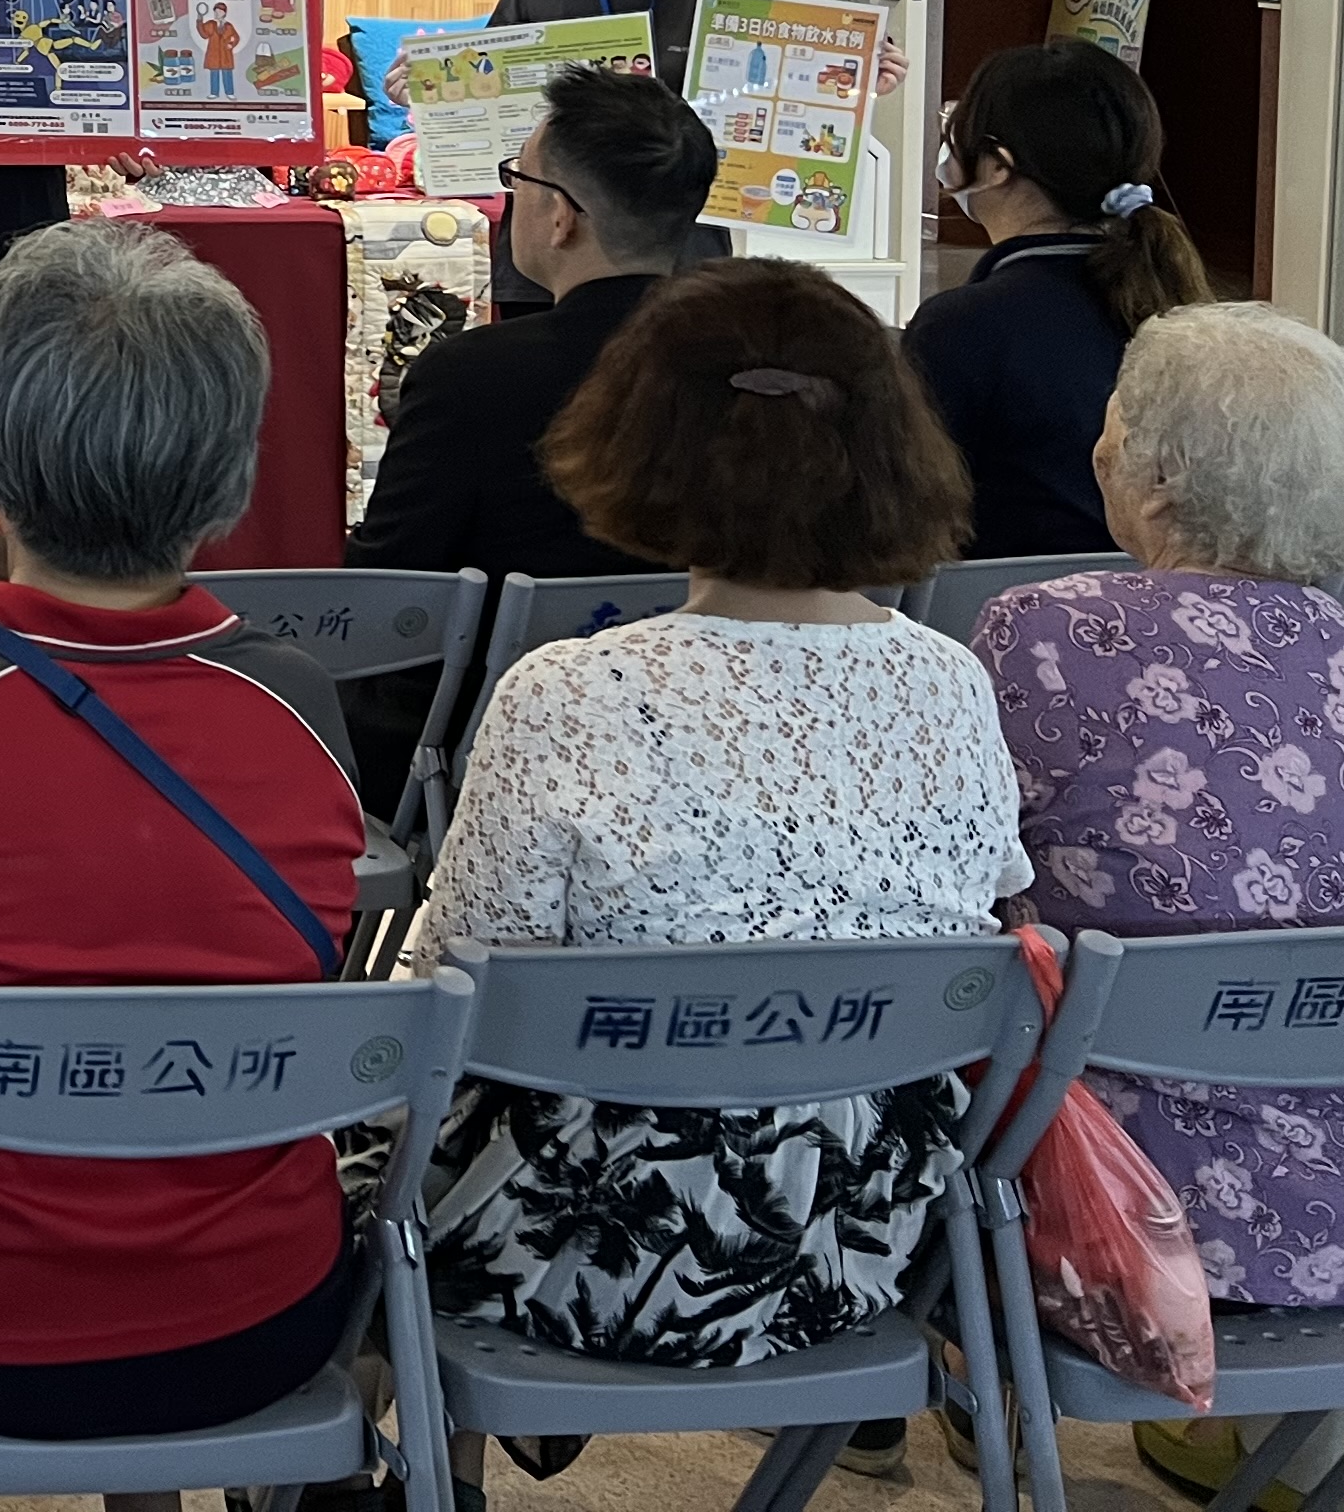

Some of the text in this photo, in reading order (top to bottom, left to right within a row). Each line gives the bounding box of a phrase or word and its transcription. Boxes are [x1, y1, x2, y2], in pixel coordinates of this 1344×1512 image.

[237, 607, 353, 641] 公所
[576, 983, 899, 1051] 南區公所
